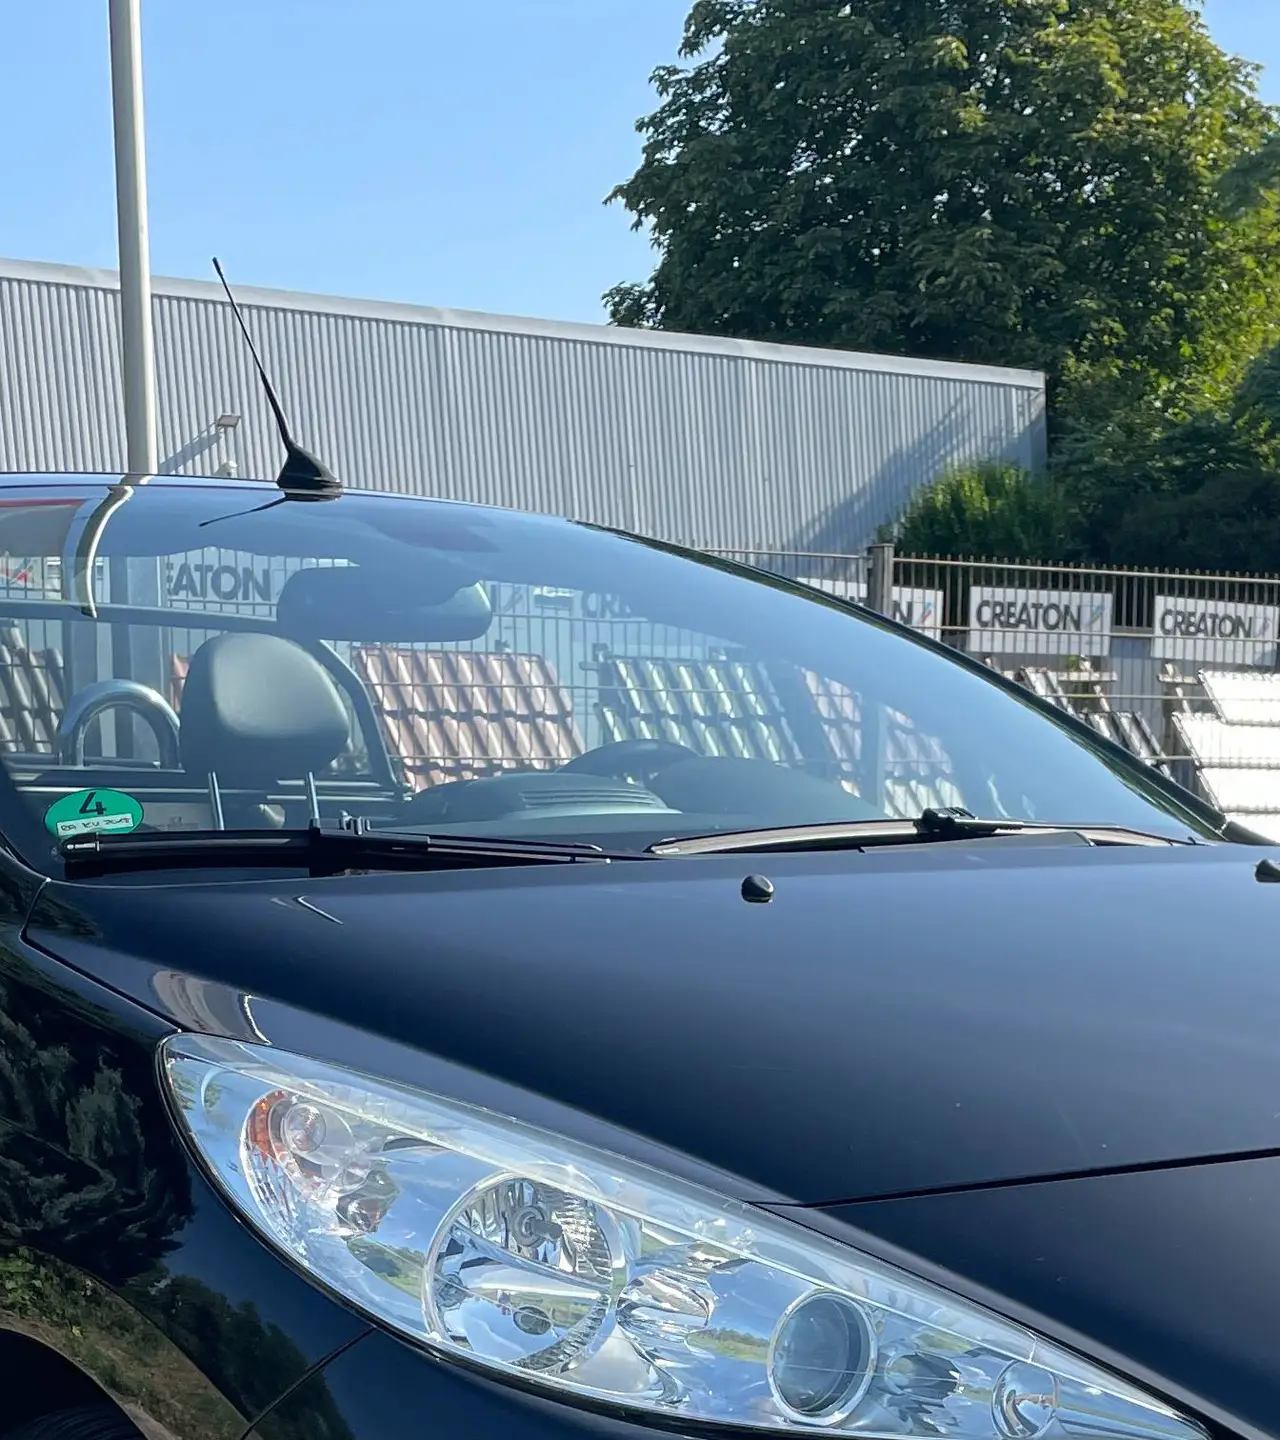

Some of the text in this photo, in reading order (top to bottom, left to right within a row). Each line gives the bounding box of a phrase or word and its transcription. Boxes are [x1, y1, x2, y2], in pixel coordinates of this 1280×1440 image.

[976, 600, 1081, 631] CREATON
[1160, 608, 1252, 638] CREATON
[78, 791, 107, 816] 4
